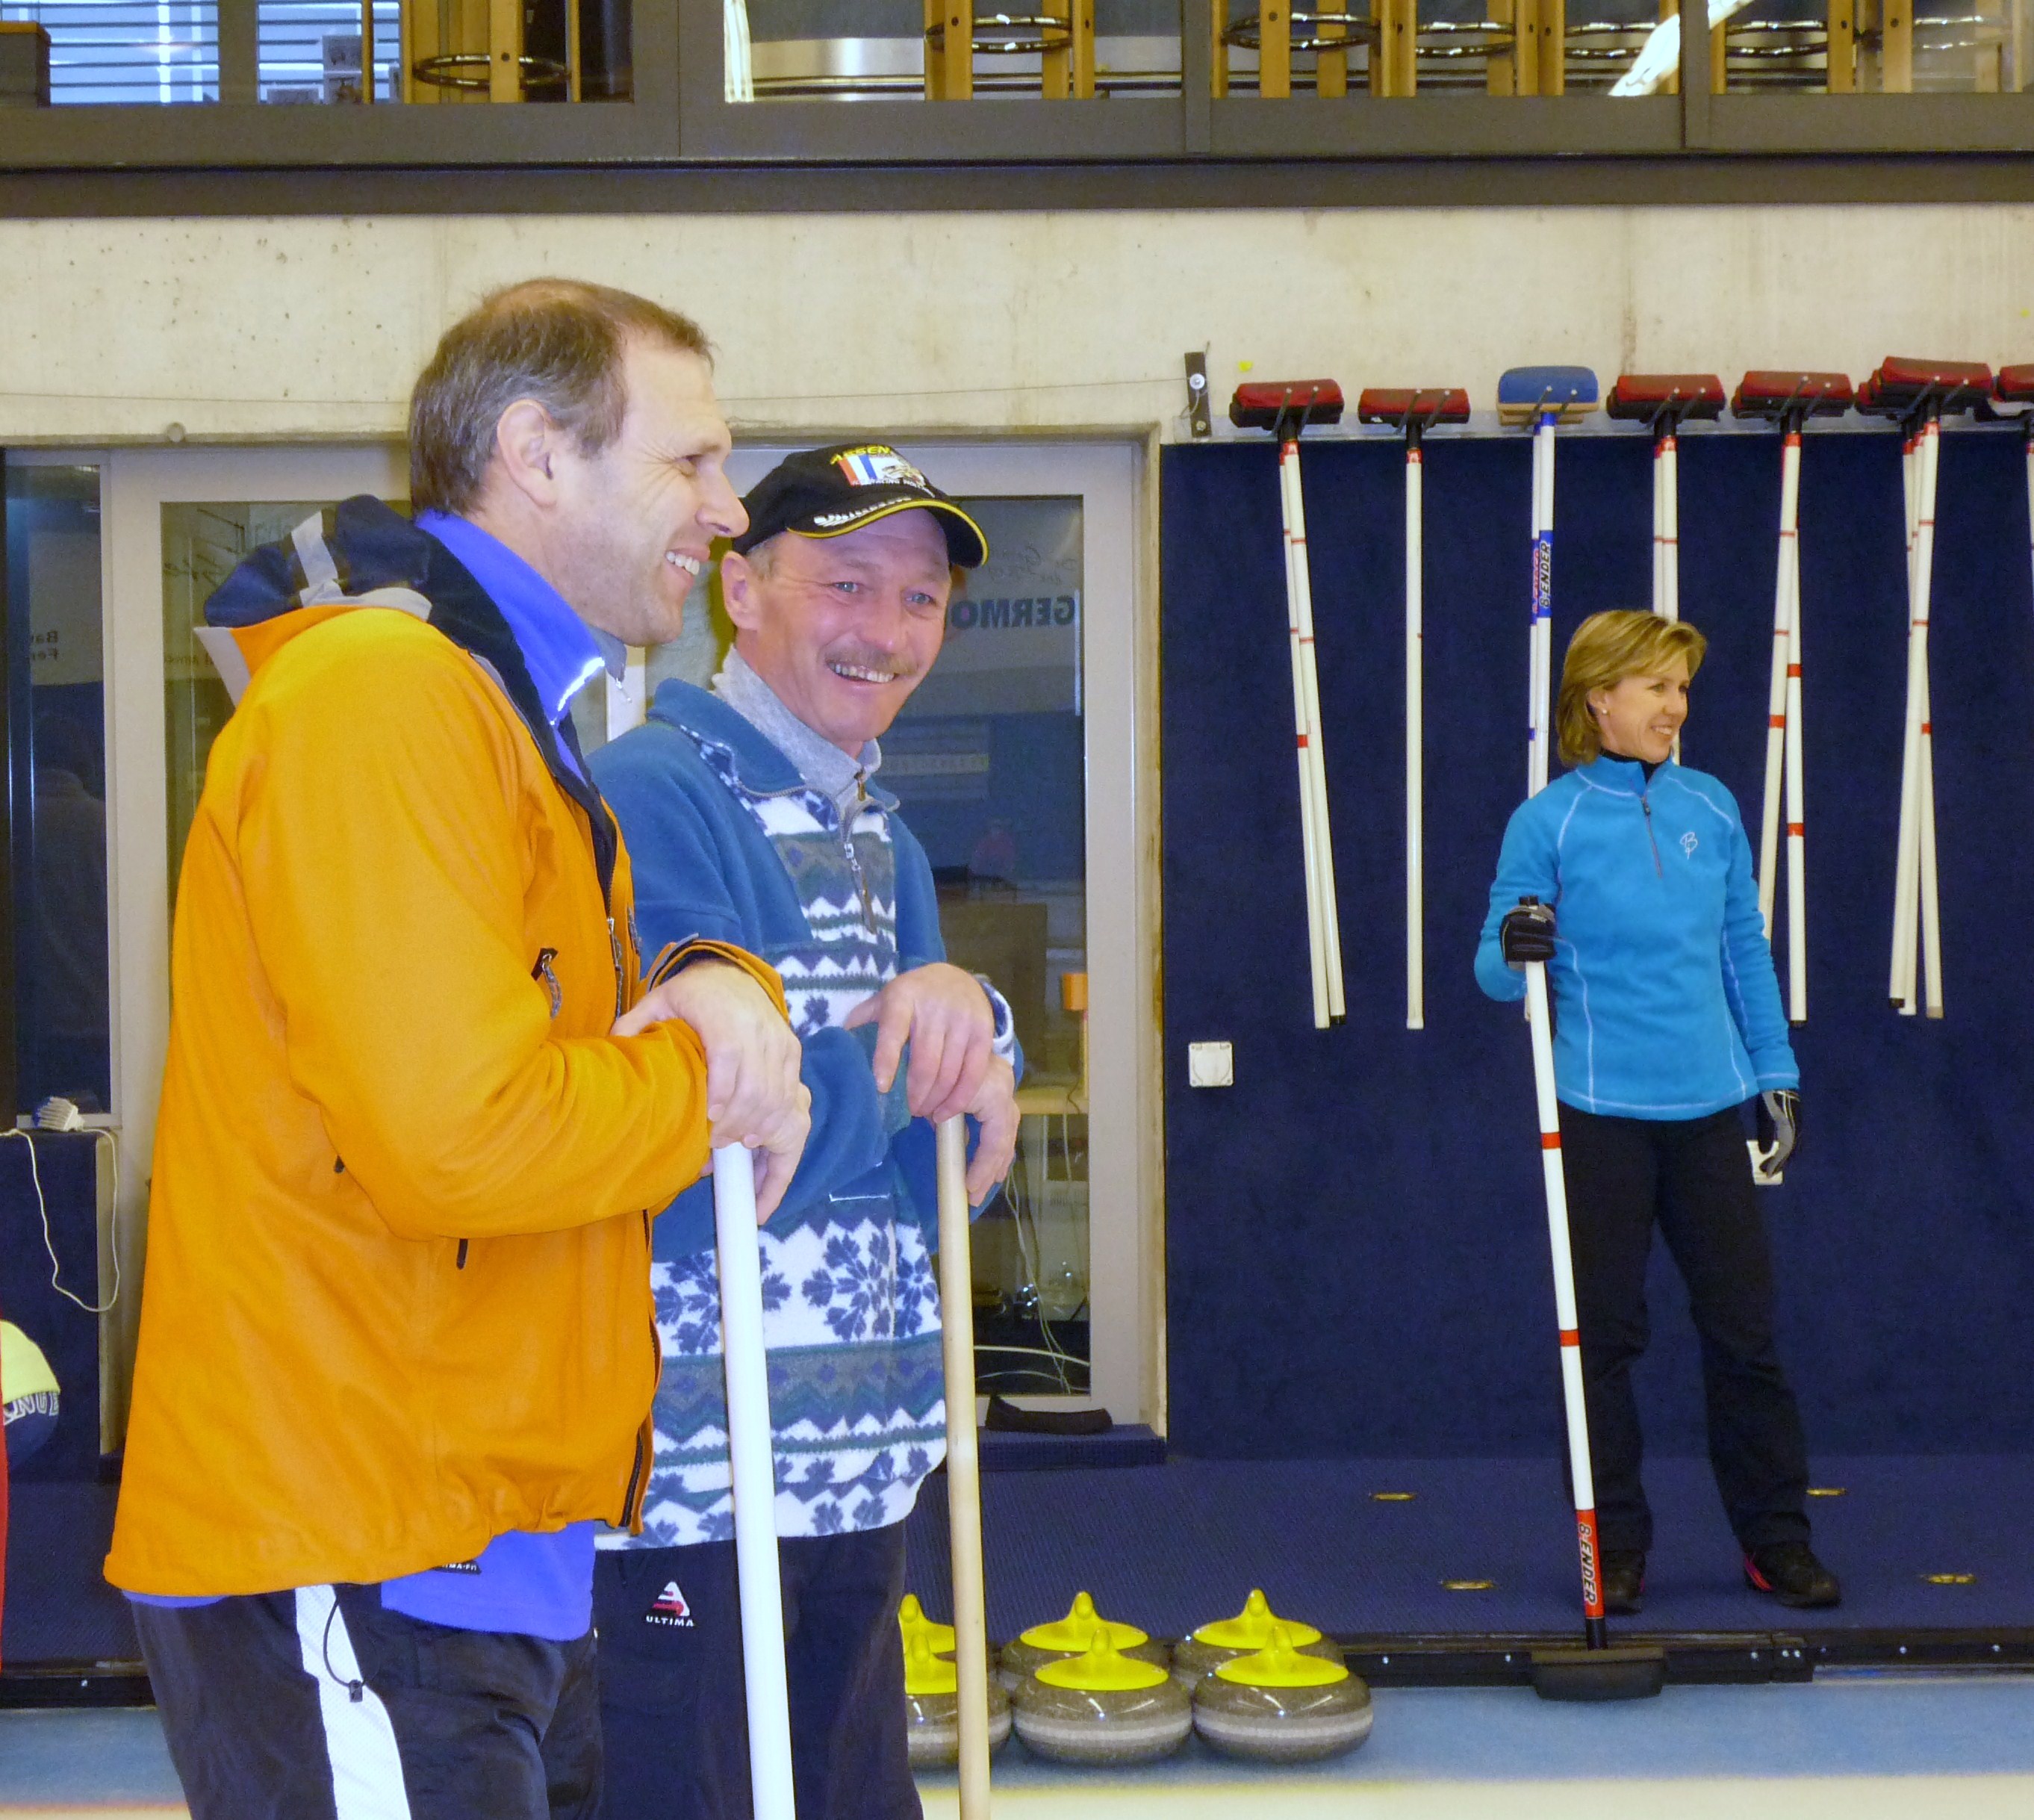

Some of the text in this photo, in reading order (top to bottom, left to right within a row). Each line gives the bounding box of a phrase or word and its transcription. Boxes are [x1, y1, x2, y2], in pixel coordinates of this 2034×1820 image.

[1540, 541, 1550, 607] 8-ENDER
[1579, 1523, 1596, 1604] 8-ENDER
[645, 1614, 694, 1627] ULTIMA
